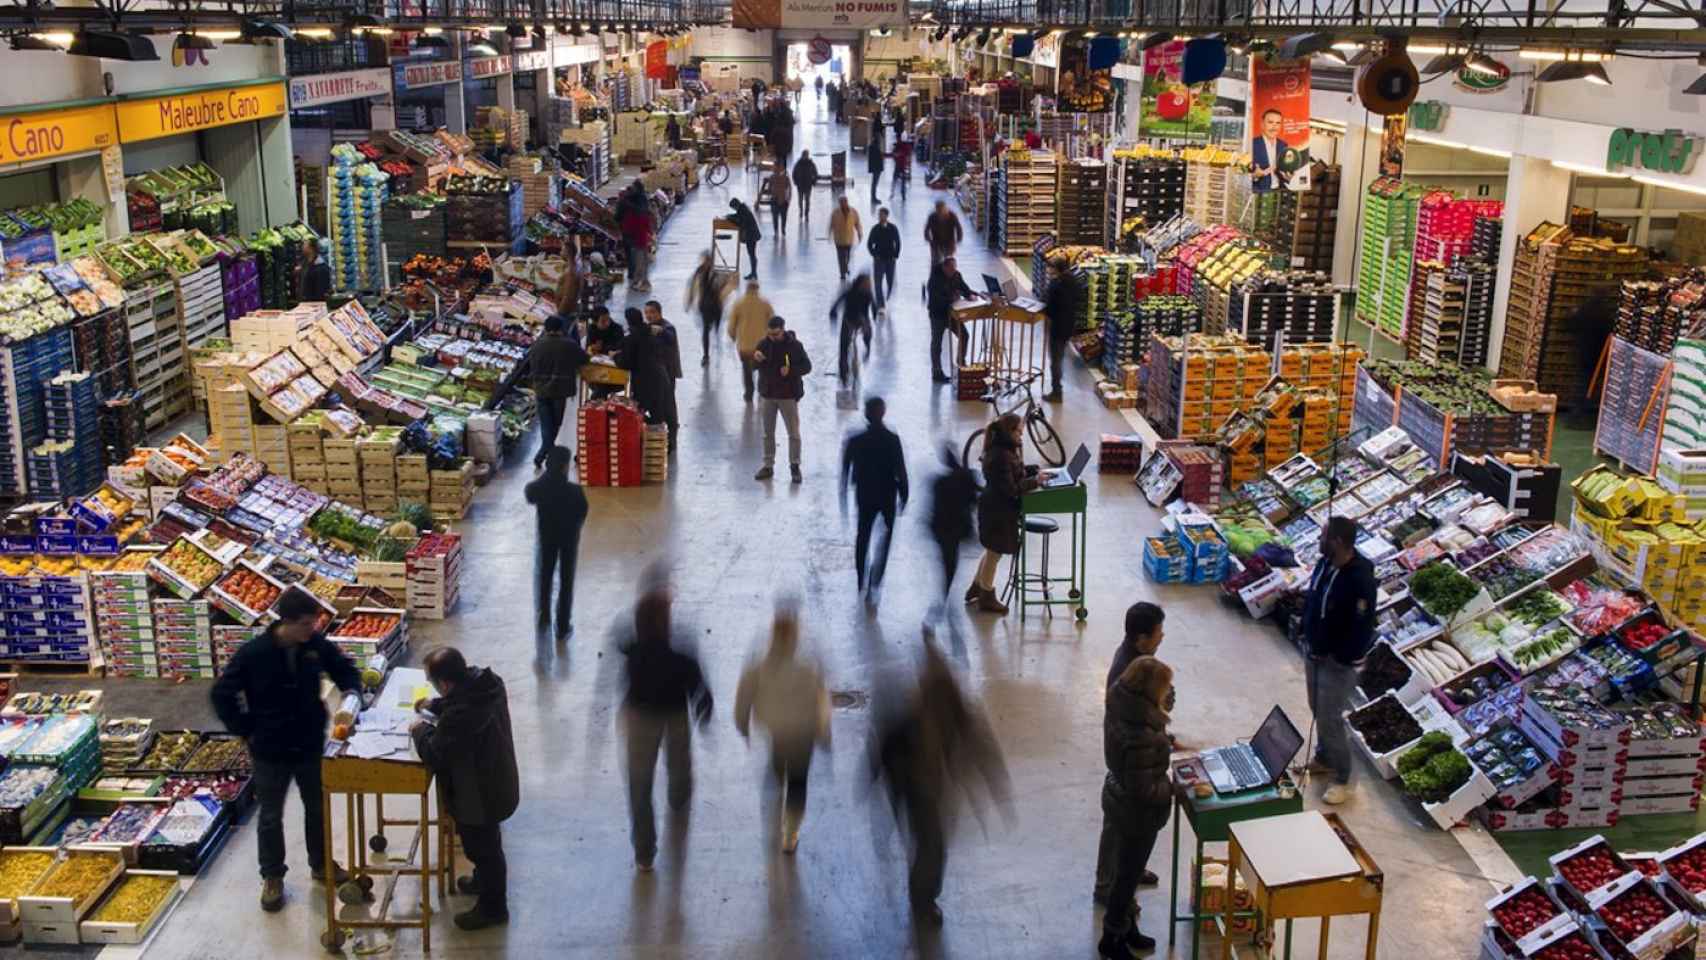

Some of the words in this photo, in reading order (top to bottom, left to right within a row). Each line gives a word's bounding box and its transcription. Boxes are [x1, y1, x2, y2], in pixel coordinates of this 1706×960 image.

[835, 2, 855, 13] NO
[858, 2, 898, 13] FUMIS
[159, 95, 225, 131] Maleubre
[227, 89, 260, 119] Cano
[8, 117, 64, 158] Cano
